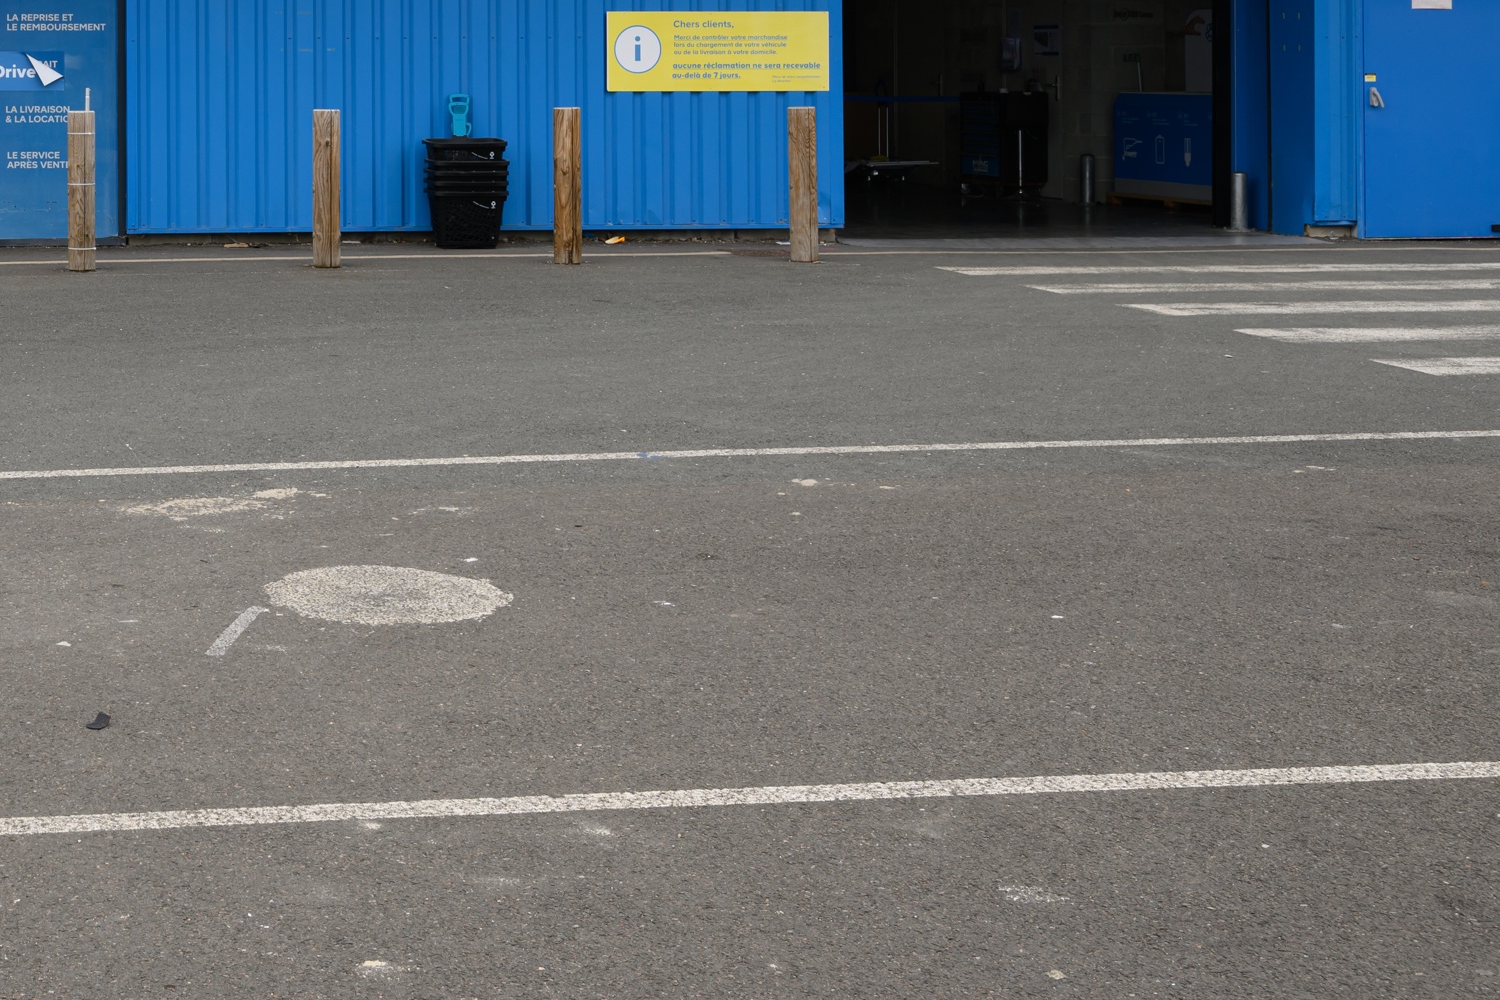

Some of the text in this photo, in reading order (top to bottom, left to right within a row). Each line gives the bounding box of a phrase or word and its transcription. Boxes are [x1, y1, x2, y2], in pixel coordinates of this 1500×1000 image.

[6, 13, 74, 22] LA REPRISE ET
[6, 23, 106, 31] LE REMBOURSEMENT
[673, 20, 735, 29] Chers clients,
[718, 72, 741, 80] jours.
[5, 105, 70, 114] LA LIVRAISON
[5, 115, 68, 123] & LA LOCATIO
[6, 151, 61, 160] LE SERVICE
[6, 158, 38, 169] APRÈS
